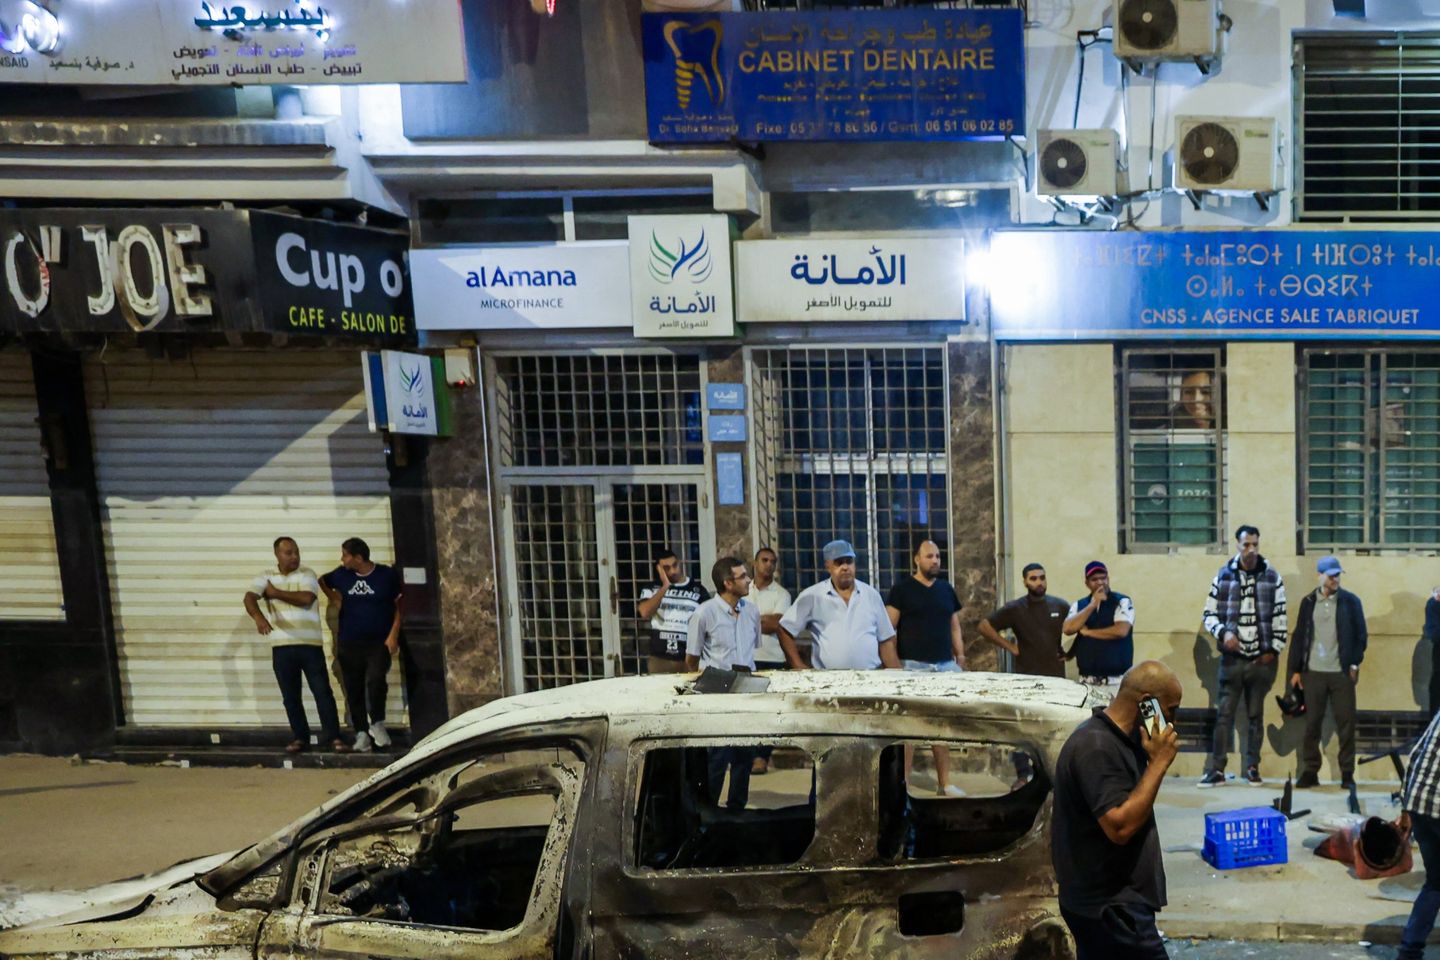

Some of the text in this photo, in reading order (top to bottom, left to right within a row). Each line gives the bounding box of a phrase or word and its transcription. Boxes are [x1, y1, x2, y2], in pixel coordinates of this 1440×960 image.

[739, 48, 995, 73] CABINET DENTAIRE
[275, 232, 365, 308] Cup
[492, 265, 578, 288] Amana
[790, 244, 906, 286] الأمانة
[480, 298, 564, 310] MICROFINANCE
[649, 289, 716, 314] الأمانة
[844, 296, 892, 311] للتمويل
[289, 305, 325, 329] CAFE
[341, 309, 386, 334] SALON
[389, 313, 407, 335] DE
[1140, 308, 1187, 324] CNSS
[1202, 308, 1274, 324] AGENCE
[1280, 308, 1320, 324] SALE
[1325, 308, 1420, 325] TABRIQUET
